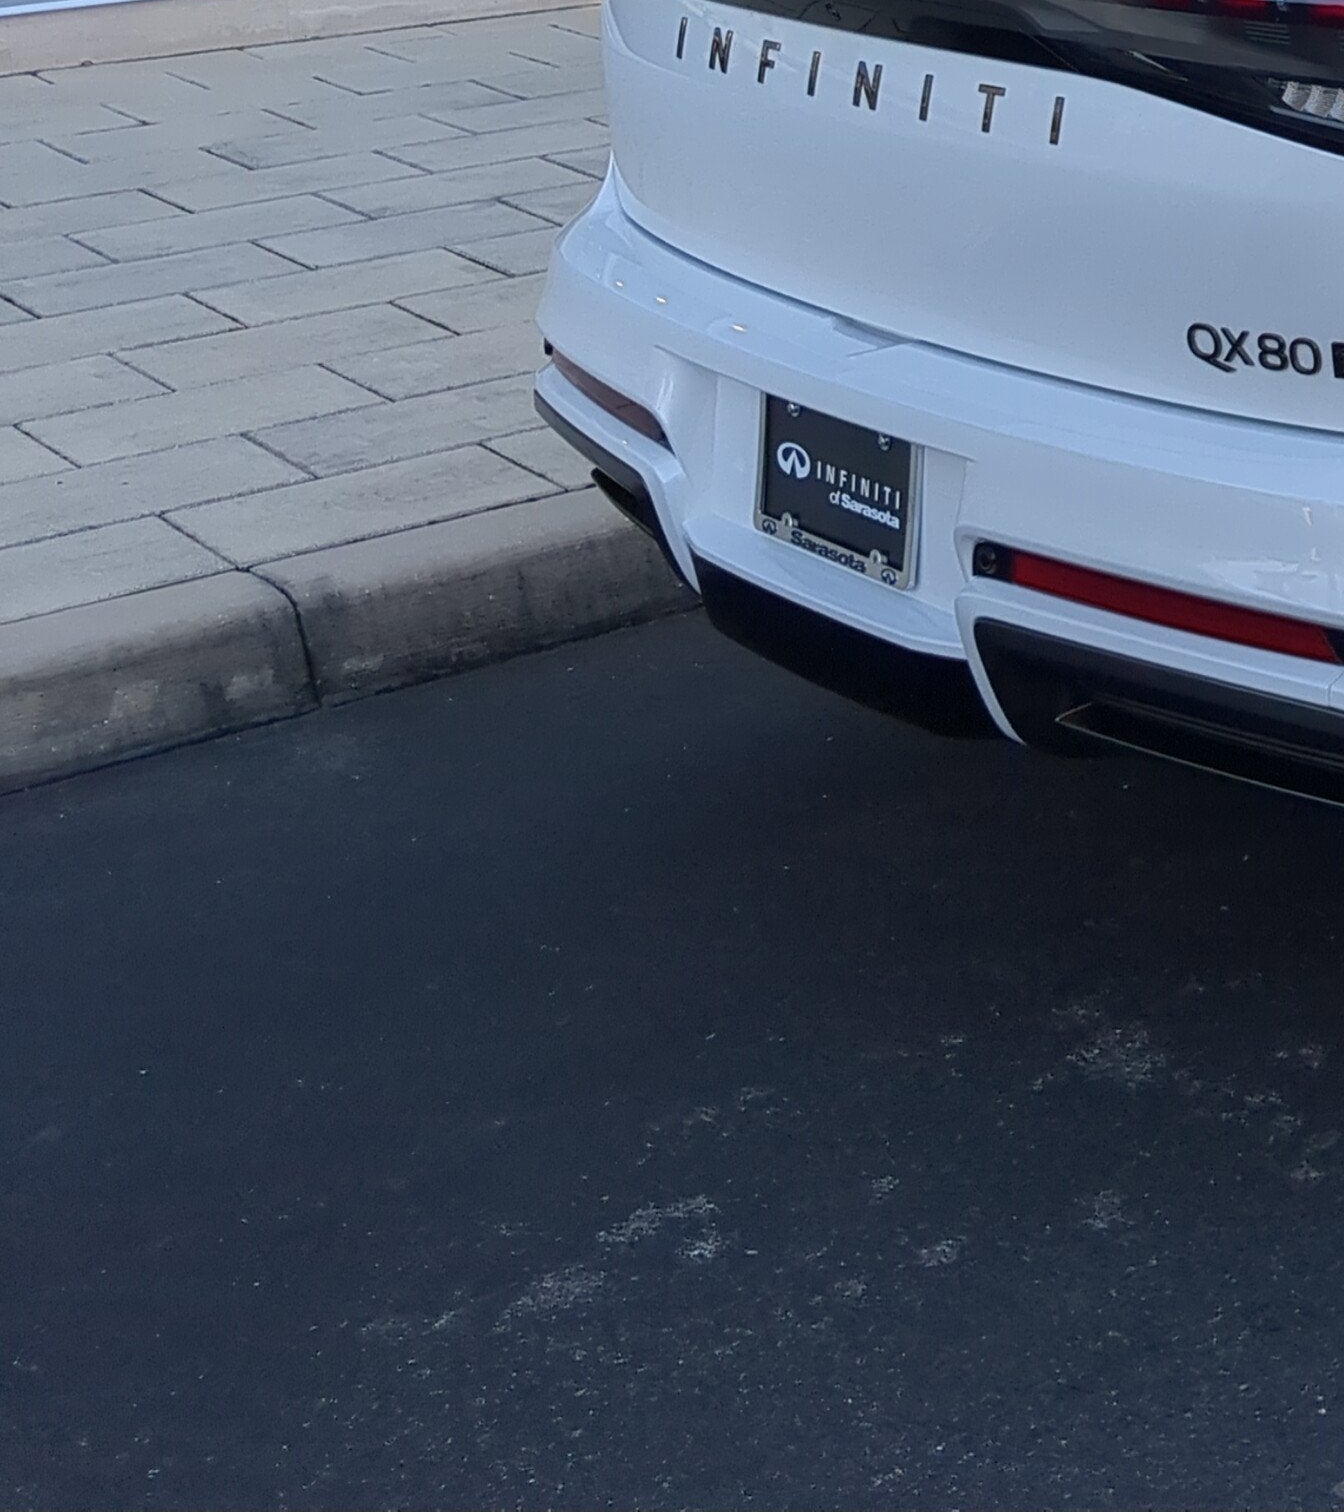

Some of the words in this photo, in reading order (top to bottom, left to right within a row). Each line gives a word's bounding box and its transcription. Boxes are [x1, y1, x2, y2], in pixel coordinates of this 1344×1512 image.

[675, 16, 1066, 146] INFINITI
[1186, 321, 1323, 376] QX80
[815, 460, 901, 510] INFINITI
[841, 493, 901, 530] Sarasota
[790, 529, 867, 574] Sarasota
